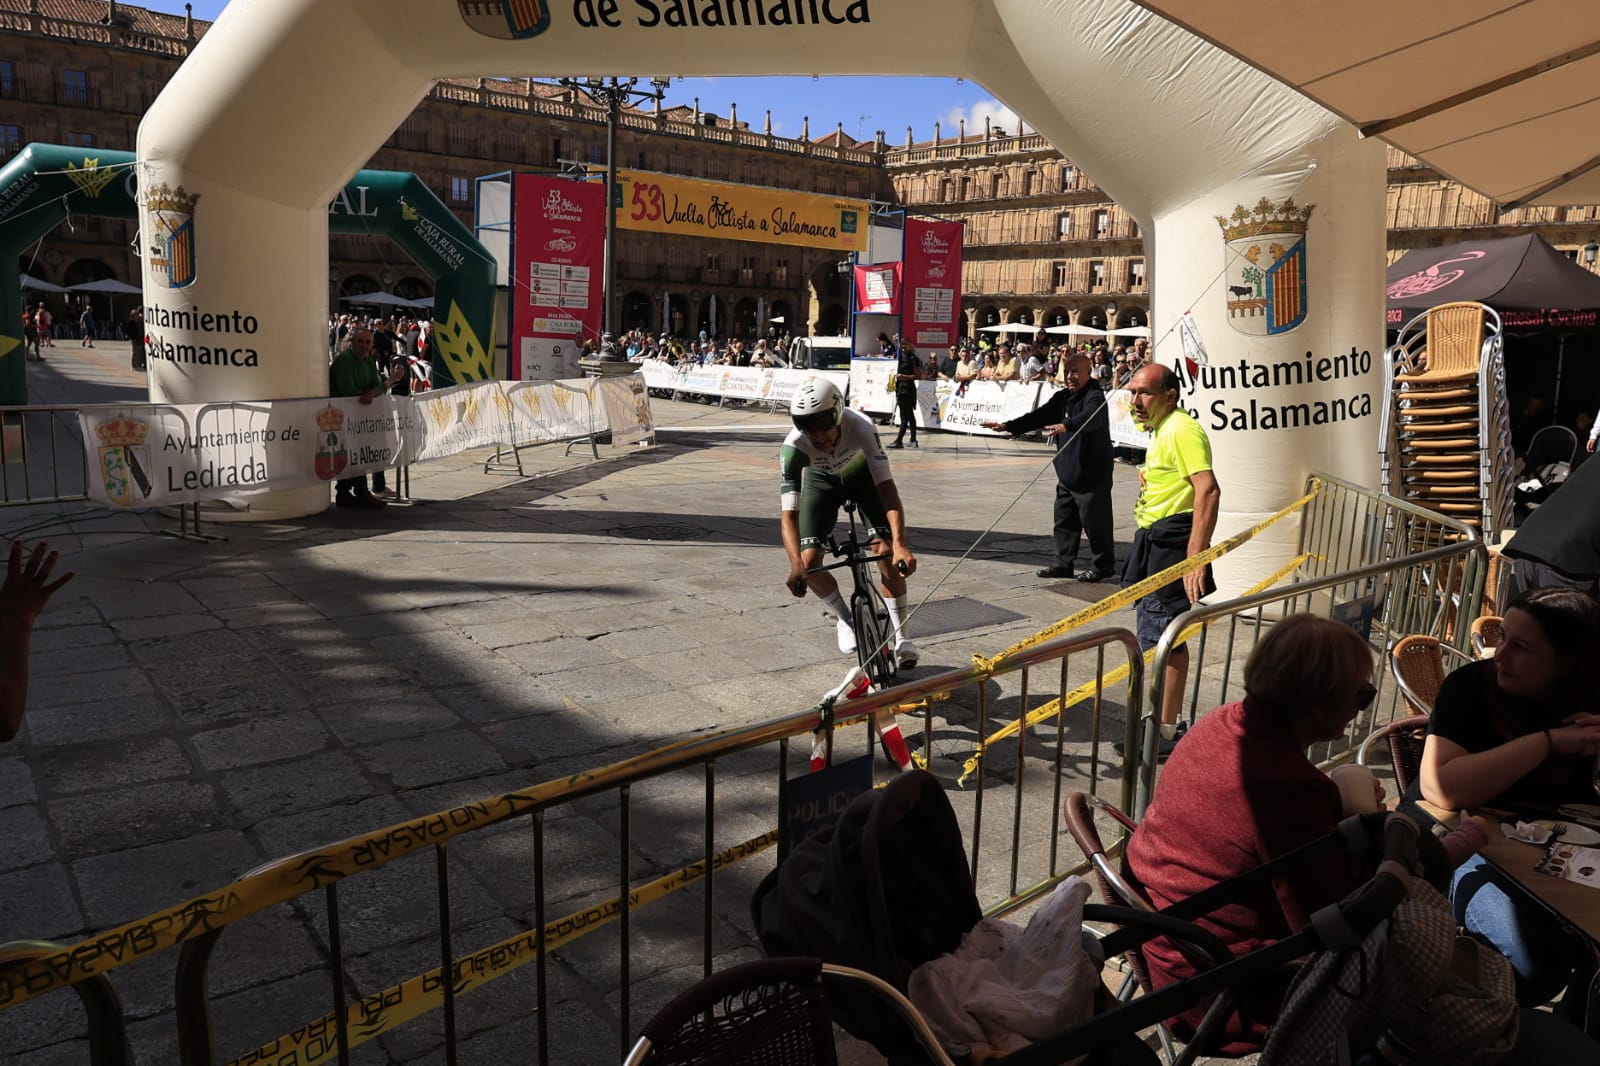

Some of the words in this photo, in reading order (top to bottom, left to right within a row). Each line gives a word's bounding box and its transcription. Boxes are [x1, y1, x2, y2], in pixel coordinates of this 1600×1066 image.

[573, 0, 622, 28] de
[637, 0, 871, 28] Salamanca
[549, 189, 561, 203] 53
[631, 181, 662, 221] 53
[661, 192, 705, 225] Vuelta
[760, 218, 769, 232] a
[771, 207, 838, 239] Salamanca
[420, 219, 441, 240] CAJA
[438, 237, 465, 265] RURAL
[1211, 393, 1372, 431] Salamanca
[163, 427, 276, 454] Ayuntamiento
[281, 425, 300, 442] de
[360, 445, 391, 465] Alberca
[167, 456, 268, 493] Ledrada
[350, 814, 448, 866] PASAR
